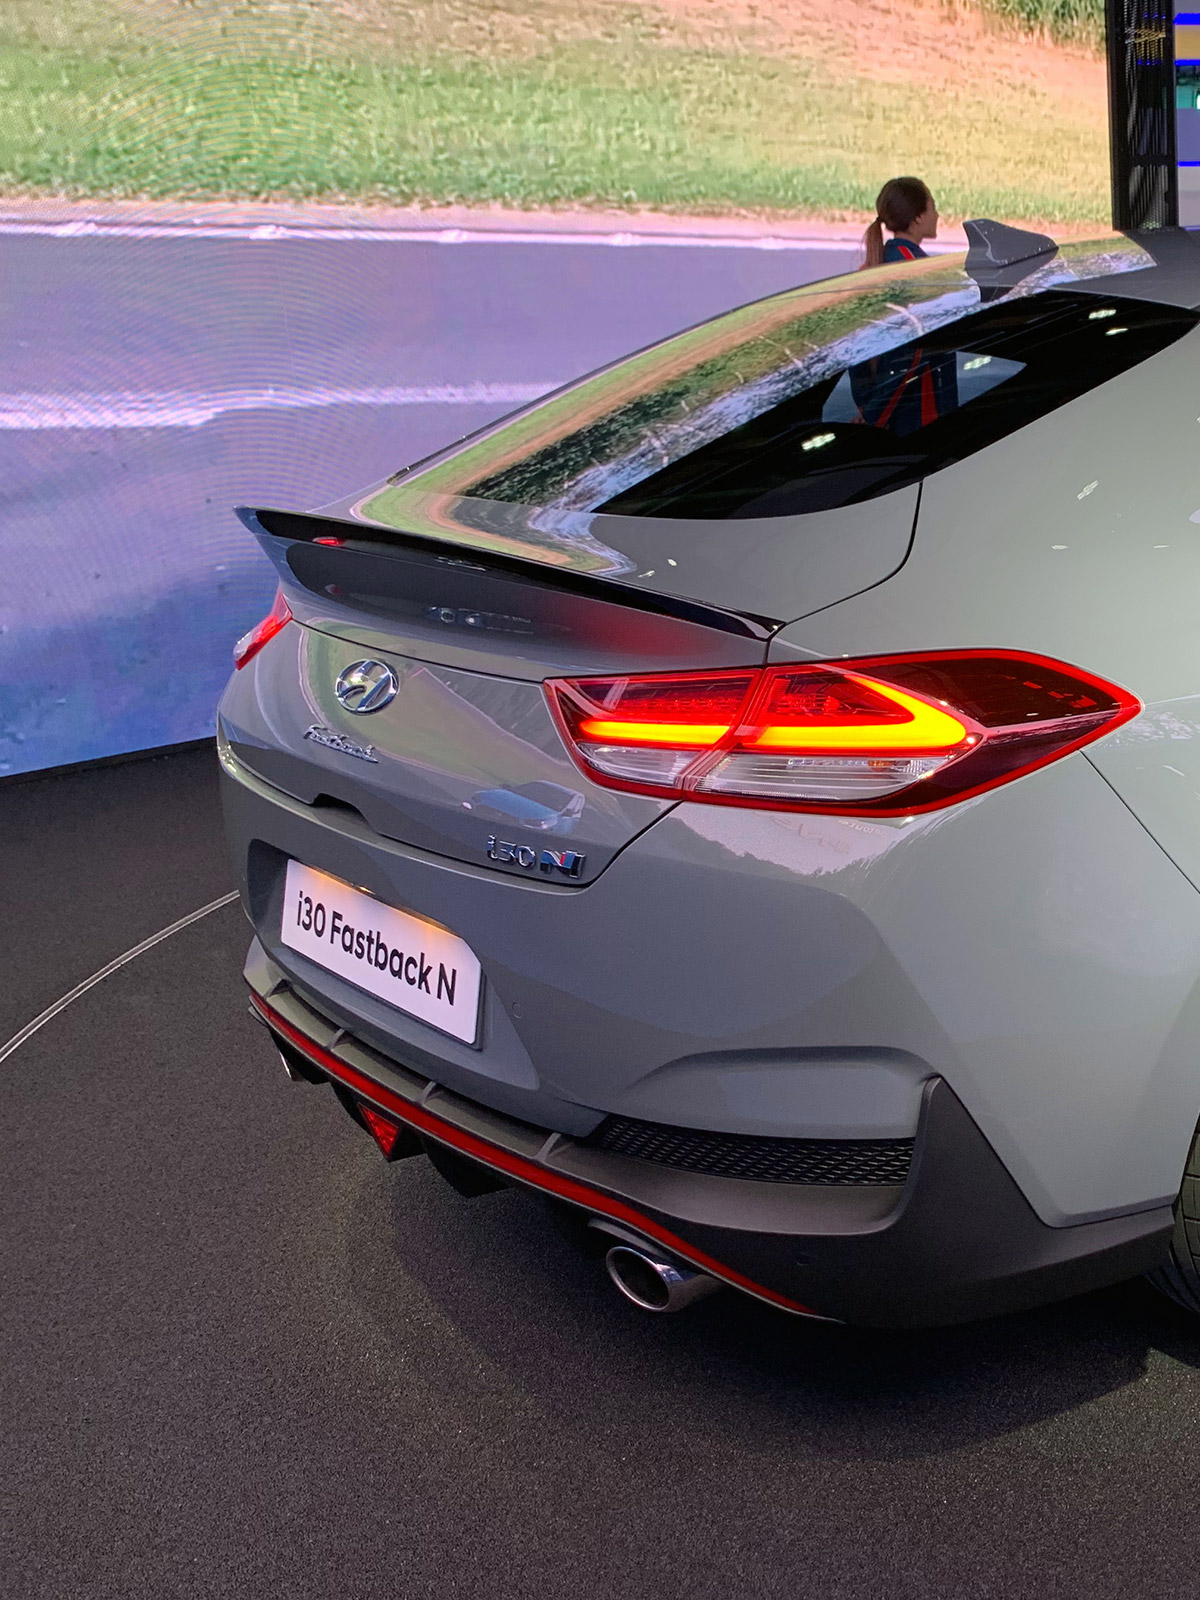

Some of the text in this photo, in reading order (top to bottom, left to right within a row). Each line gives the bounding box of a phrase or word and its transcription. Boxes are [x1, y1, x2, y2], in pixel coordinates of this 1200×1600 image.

[486, 834, 586, 879] i30 N
[296, 891, 457, 1007] i30 Fastback N
